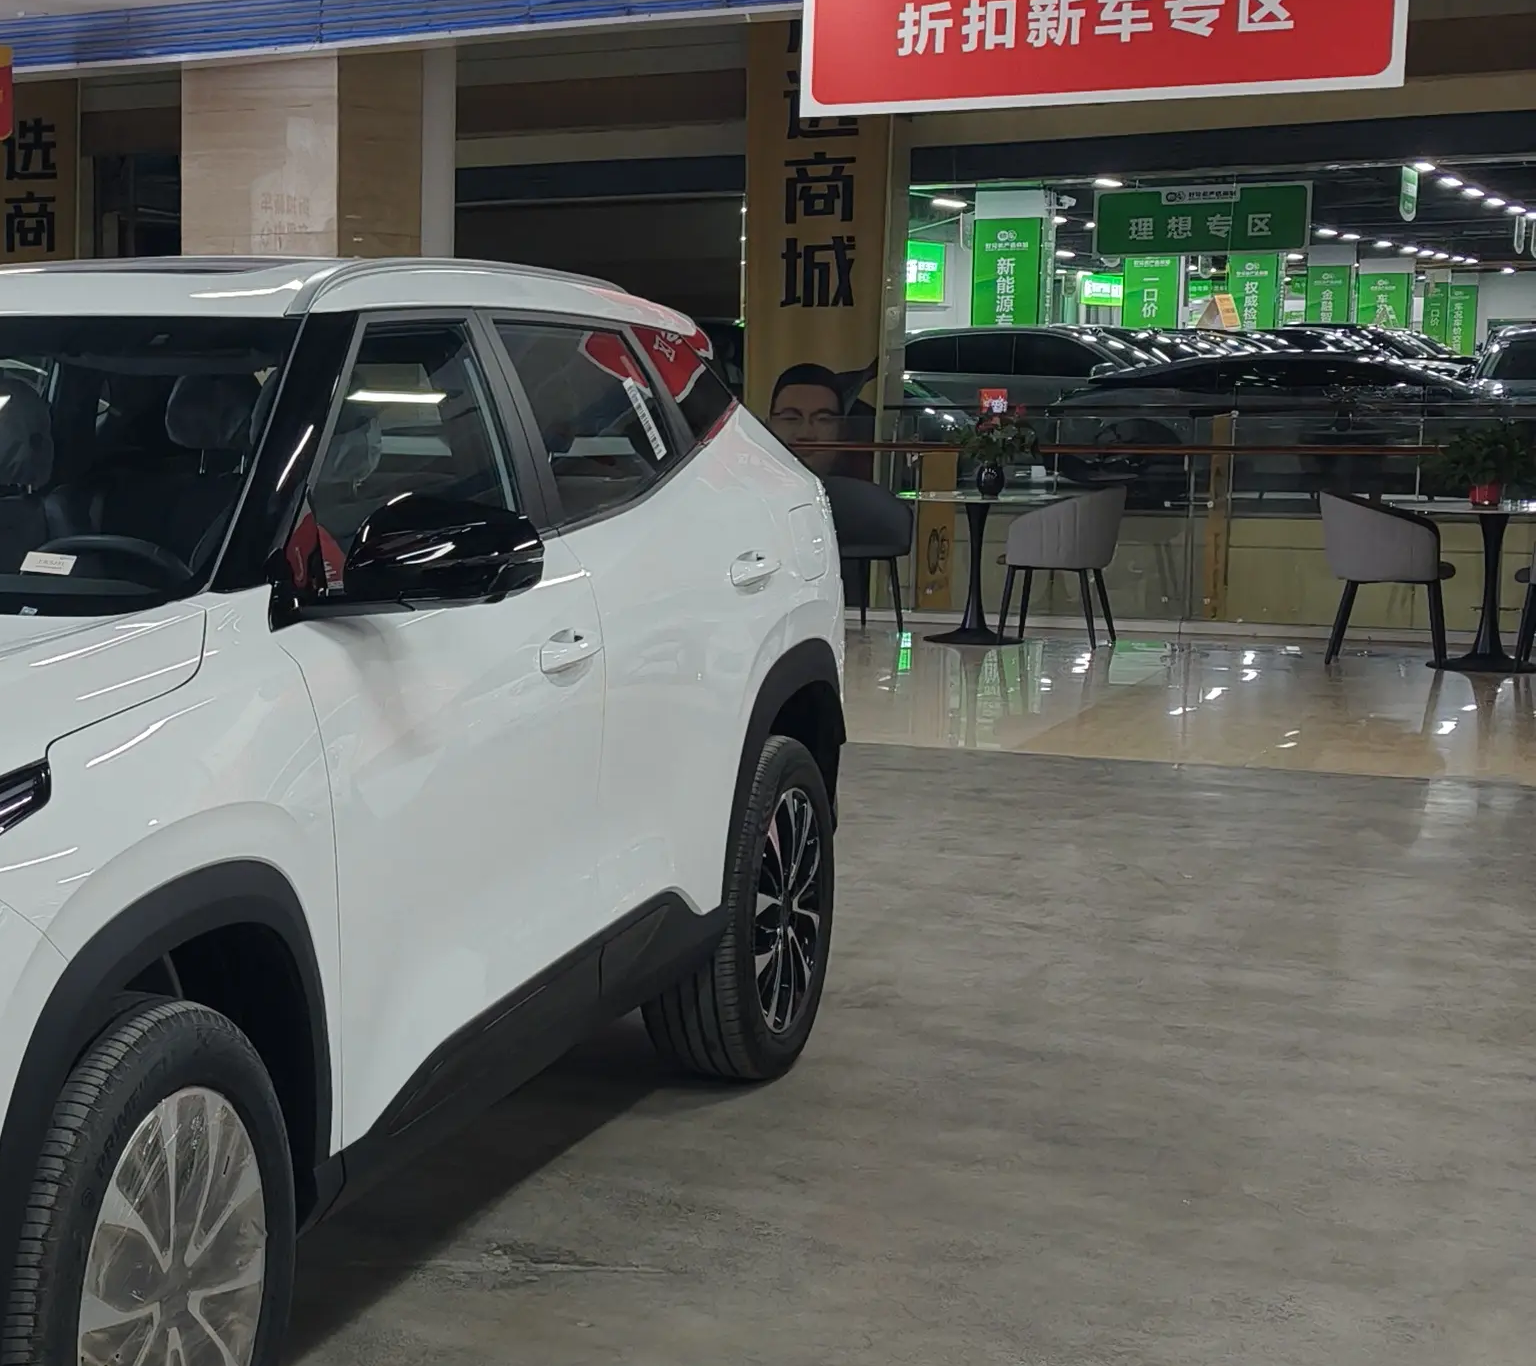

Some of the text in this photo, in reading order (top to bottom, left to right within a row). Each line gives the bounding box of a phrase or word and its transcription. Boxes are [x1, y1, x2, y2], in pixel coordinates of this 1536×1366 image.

[1128, 212, 1272, 241] 理想专区
[1141, 277, 1160, 318] 一口价
